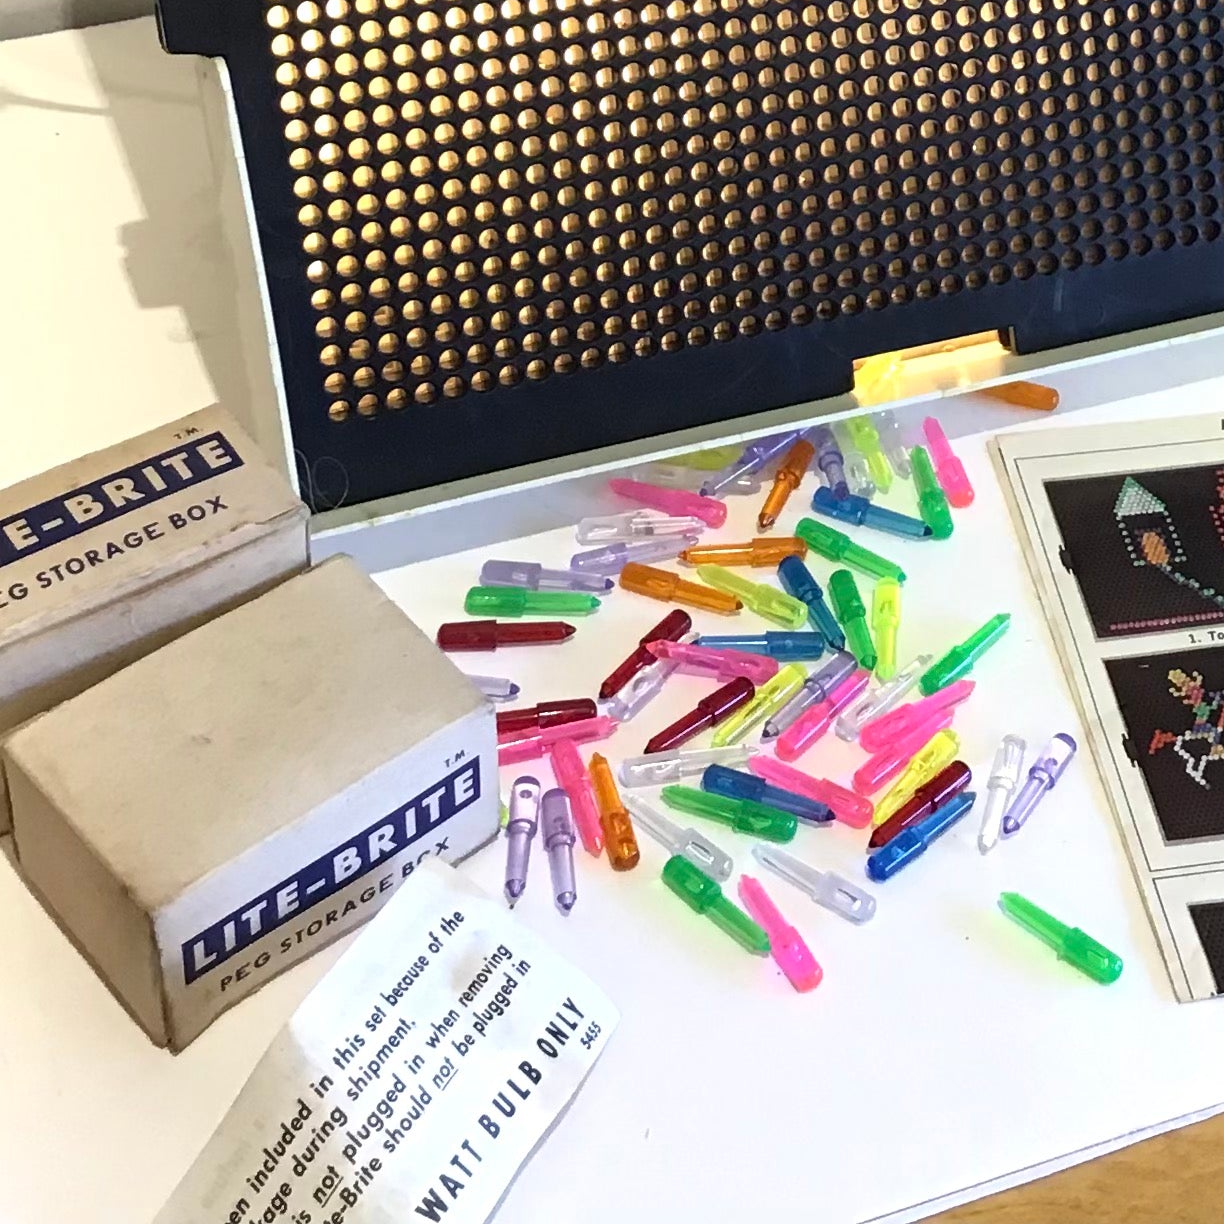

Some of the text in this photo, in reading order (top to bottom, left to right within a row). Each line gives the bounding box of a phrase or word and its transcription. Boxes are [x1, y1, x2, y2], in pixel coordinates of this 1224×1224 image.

[3, 439, 233, 551] E-BRITE
[36, 522, 165, 589] STORAGE
[168, 495, 228, 530] BOX
[1189, 634, 1201, 643] 1.
[188, 767, 475, 973] LITE-BRITE
[221, 952, 270, 991] PEG
[281, 874, 392, 953] STORAGE
[224, 912, 464, 1224] en included in this set because of the
[292, 1107, 347, 1176] during
[347, 1018, 415, 1101] shipment.
[313, 1166, 339, 1204] not
[342, 1073, 406, 1165] plugged
[404, 1055, 425, 1074] in
[426, 1010, 460, 1048] when
[459, 945, 512, 1007] removing
[383, 1085, 432, 1153] should
[433, 1057, 454, 1089] not
[452, 1035, 475, 1056] be
[473, 972, 518, 1037] plugged
[512, 960, 531, 976] in
[415, 997, 584, 1223] WATT BULB ONLY
[580, 1021, 601, 1049] 5455
